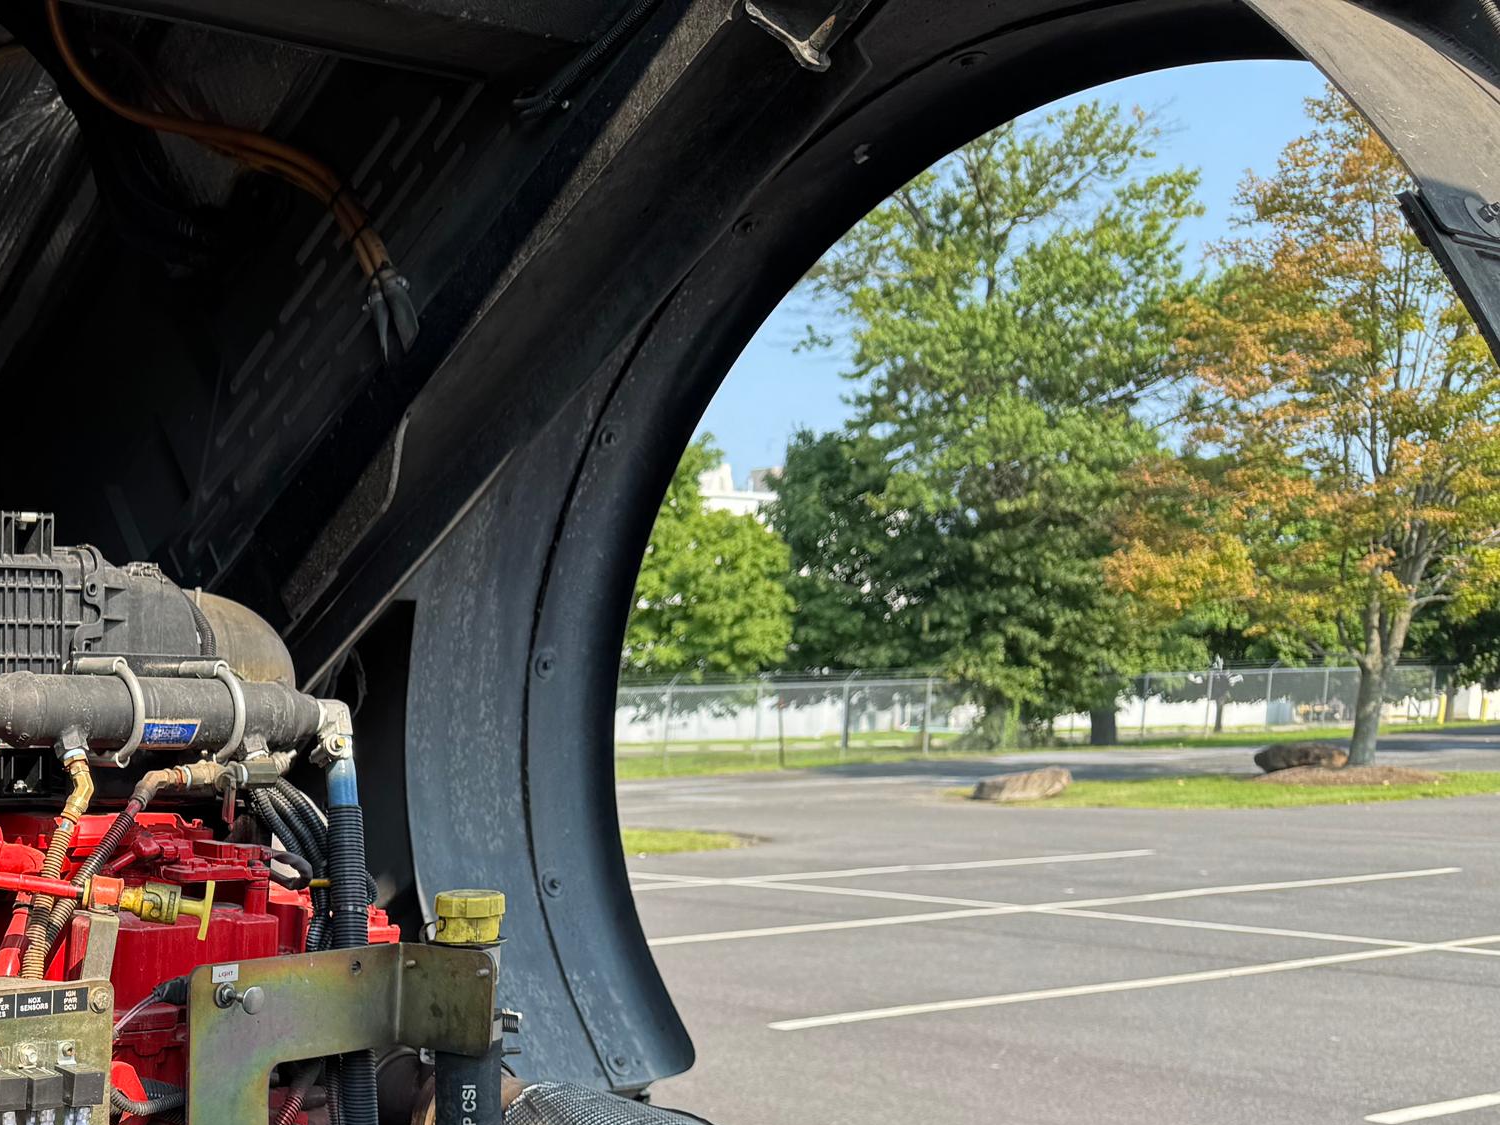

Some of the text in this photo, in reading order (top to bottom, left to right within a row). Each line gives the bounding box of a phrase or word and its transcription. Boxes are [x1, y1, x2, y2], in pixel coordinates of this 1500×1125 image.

[27, 996, 41, 1004] NOX
[19, 1003, 49, 1012] SENSORS
[462, 1084, 476, 1112] CSI
